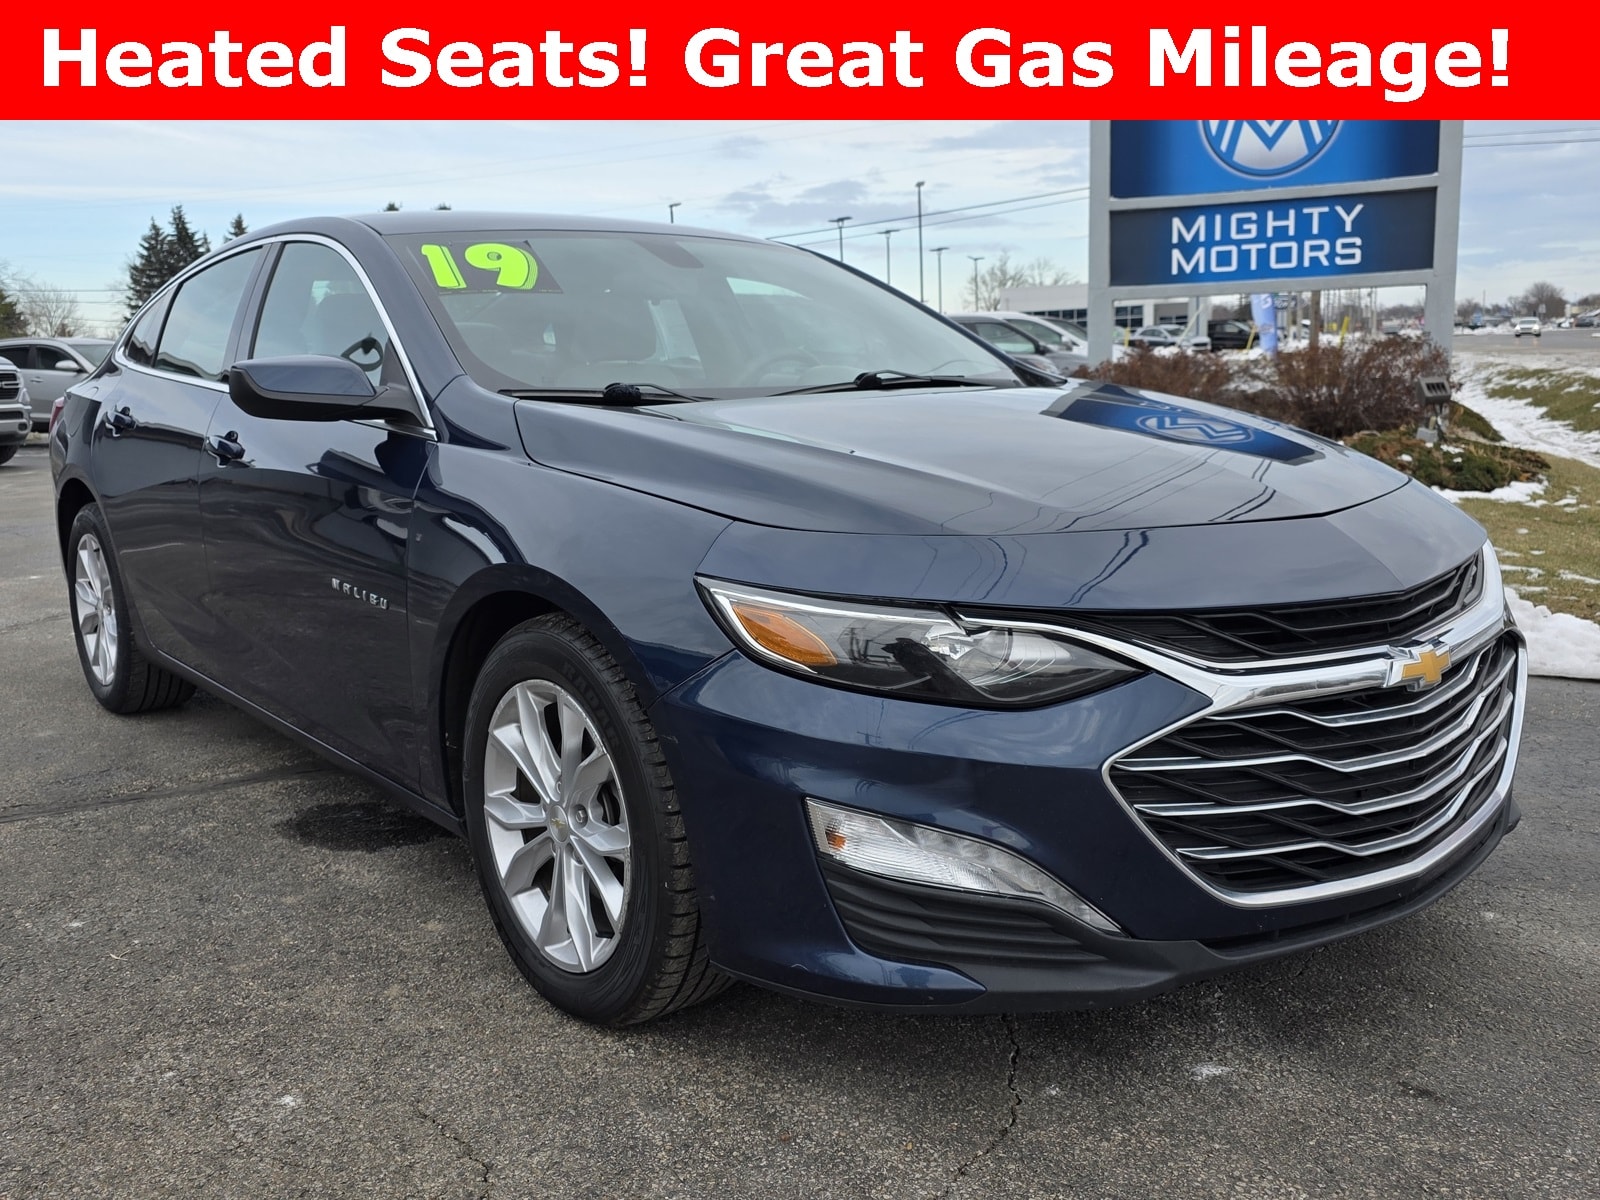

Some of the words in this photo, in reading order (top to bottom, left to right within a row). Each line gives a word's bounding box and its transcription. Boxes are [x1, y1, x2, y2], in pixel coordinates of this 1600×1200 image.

[1171, 203, 1364, 244] MIGHTY
[421, 242, 538, 290] 19
[1171, 237, 1363, 276] MOTORS
[331, 577, 388, 610] MALIBU
